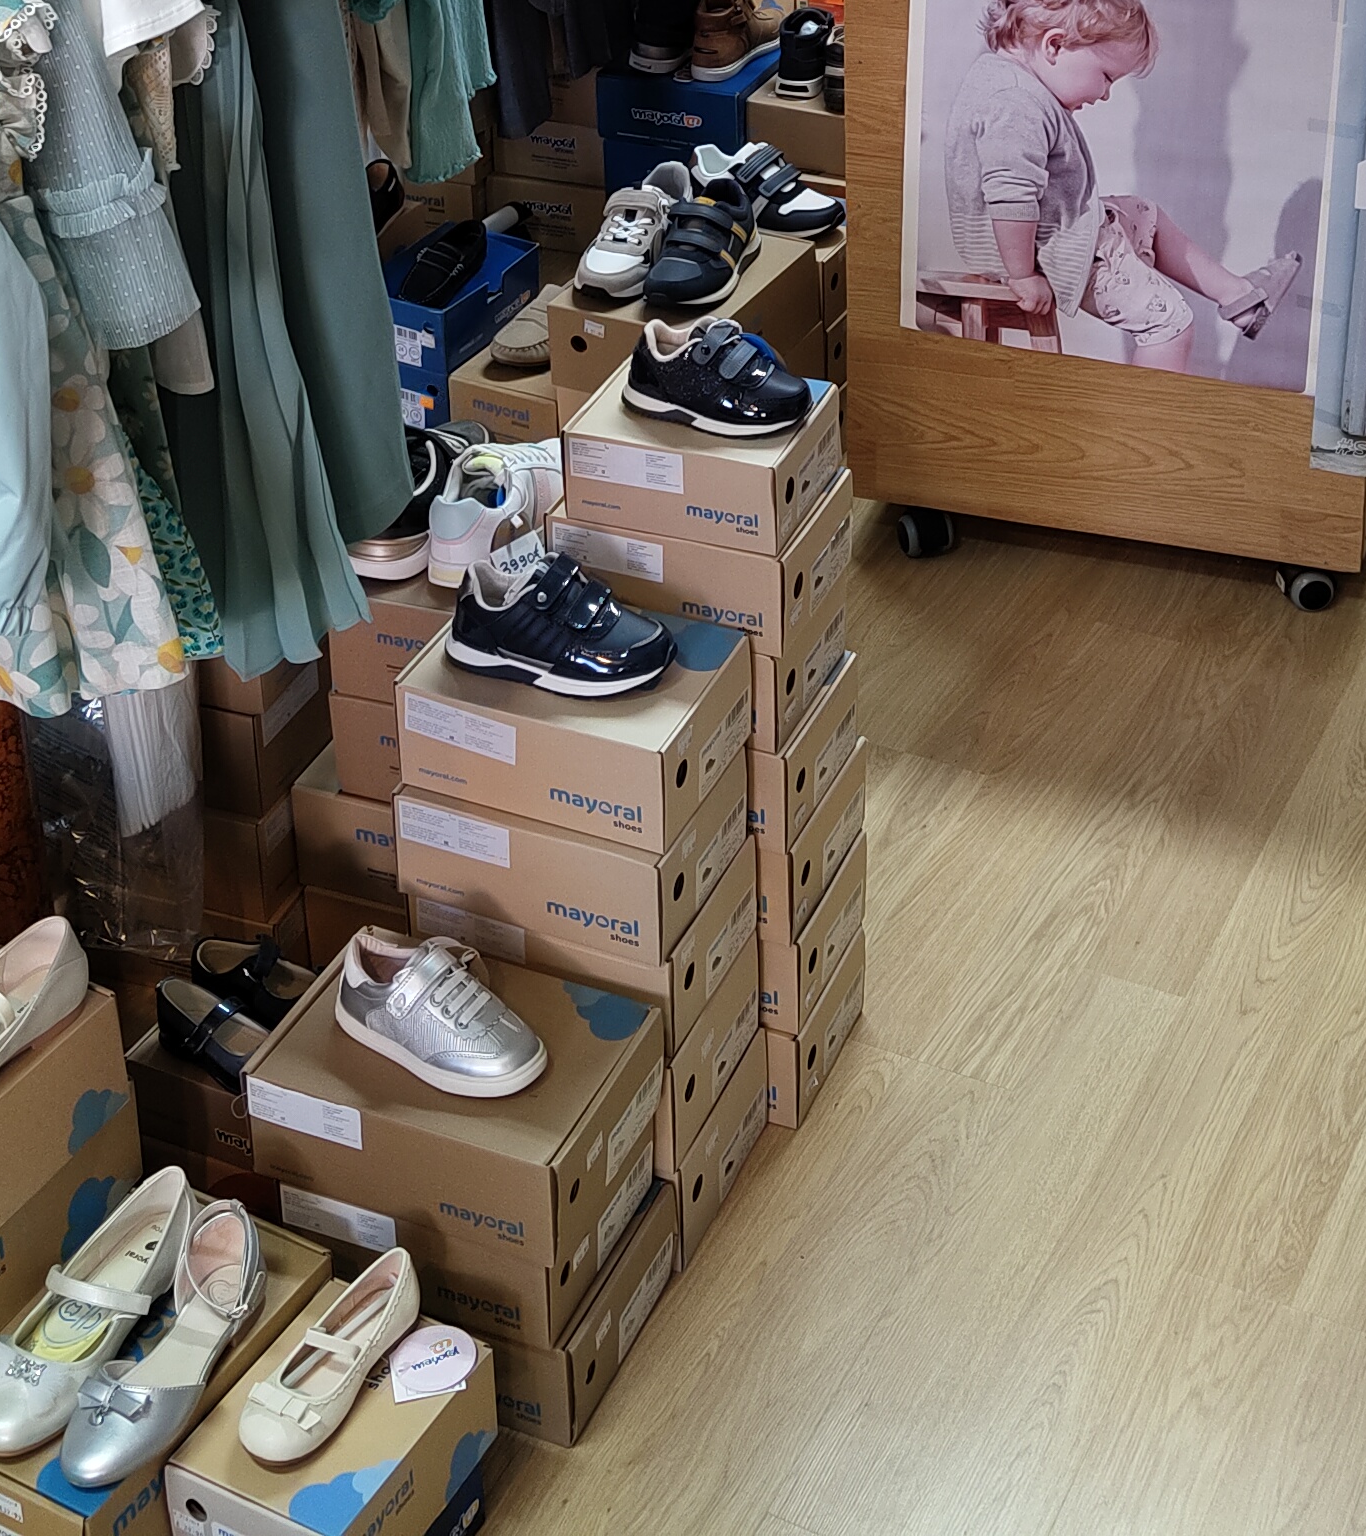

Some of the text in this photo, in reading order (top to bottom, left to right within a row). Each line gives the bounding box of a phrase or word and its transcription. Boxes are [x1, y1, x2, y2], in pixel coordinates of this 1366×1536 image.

[631, 107, 685, 126] mayoral
[530, 133, 577, 150] mayoral
[523, 200, 574, 216] mayoral
[472, 397, 530, 422] mayoral
[686, 504, 759, 528] mayoral
[735, 526, 759, 536] shoes
[682, 601, 764, 628] mayoral
[418, 766, 468, 786] mayoral.com
[549, 786, 643, 824] mayoral
[612, 818, 644, 834] shoes
[546, 899, 641, 938] mayoral
[609, 931, 641, 947] shoes
[438, 1201, 525, 1237] mayoral
[497, 1231, 526, 1247] shoes
[436, 1284, 521, 1321] mayoral
